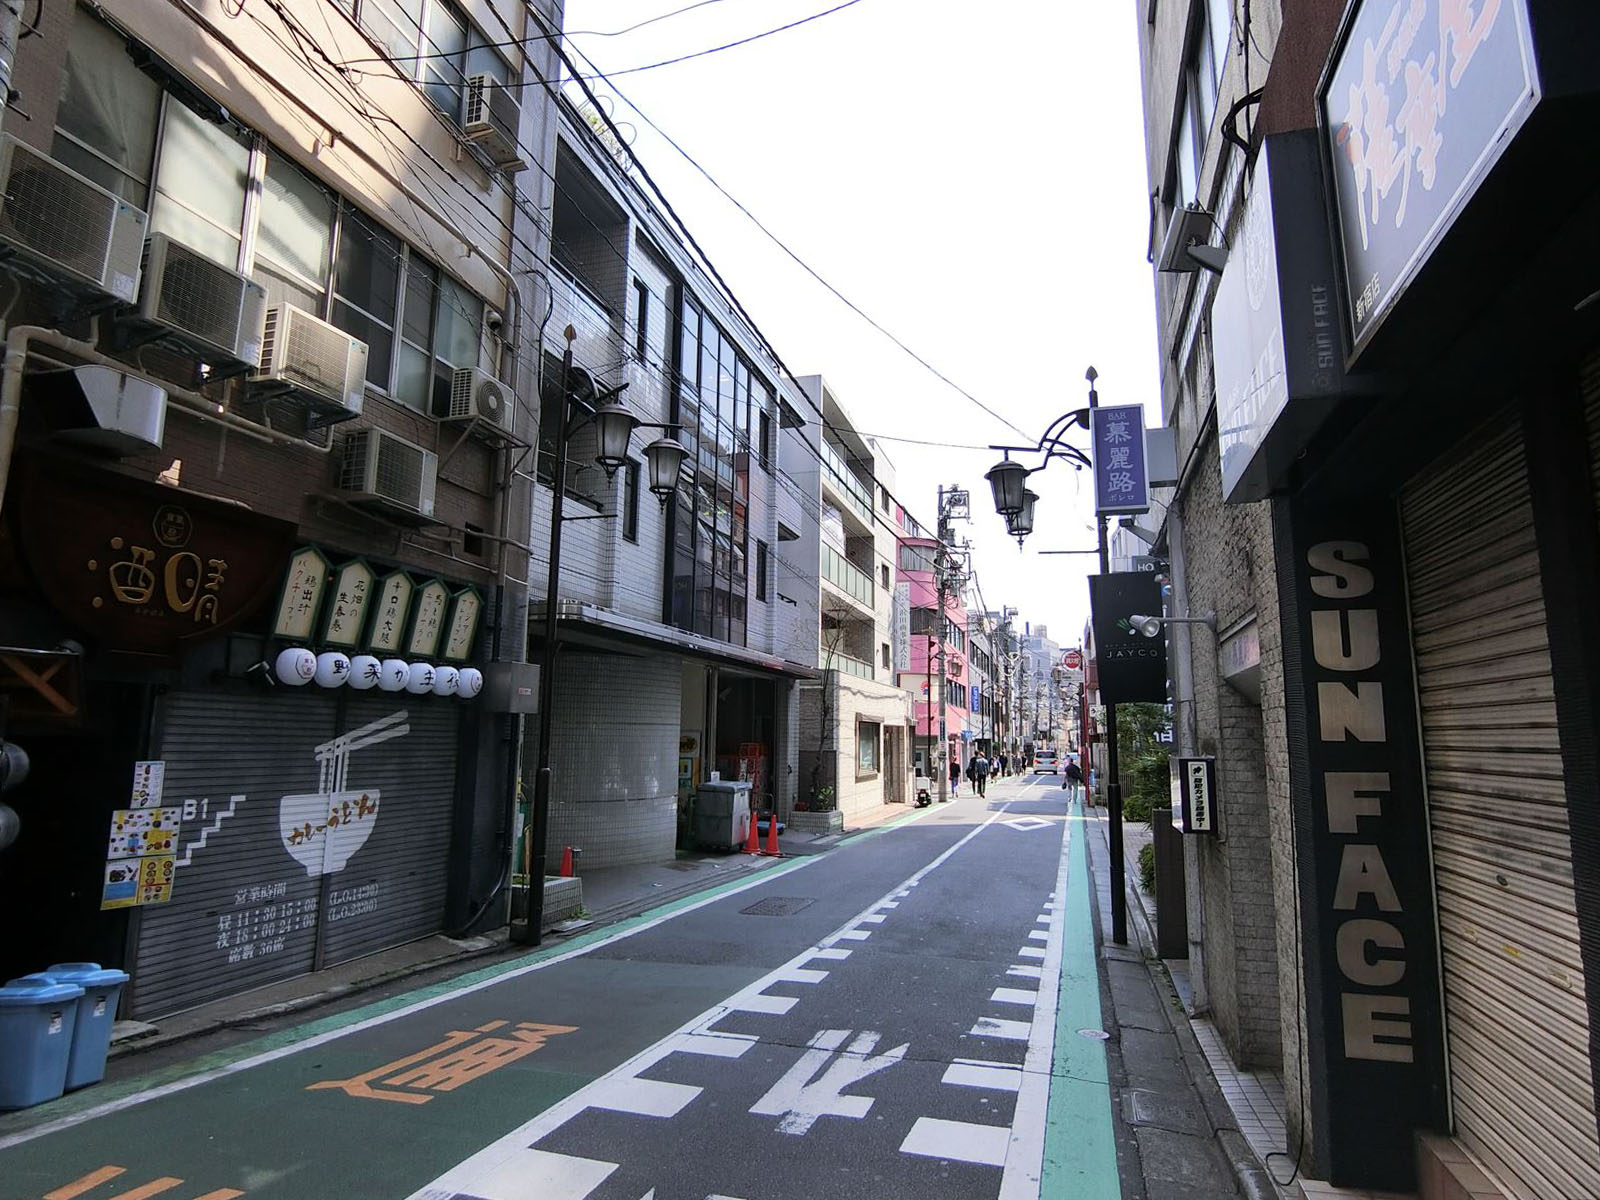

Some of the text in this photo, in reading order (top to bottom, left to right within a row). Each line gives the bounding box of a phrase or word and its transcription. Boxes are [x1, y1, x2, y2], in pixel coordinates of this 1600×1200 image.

[1356, 271, 1381, 323] 新宿店
[1311, 285, 1335, 369] SUN FACE
[1104, 421, 1137, 493] 慕麗路
[1105, 648, 1158, 659] JAYCO
[182, 798, 209, 822] B1
[286, 793, 377, 846] カレーうどん
[1305, 539, 1415, 1063] SUN FACE
[233, 882, 287, 905] 営業時間
[216, 932, 231, 949] 夜
[218, 915, 232, 931] 昼
